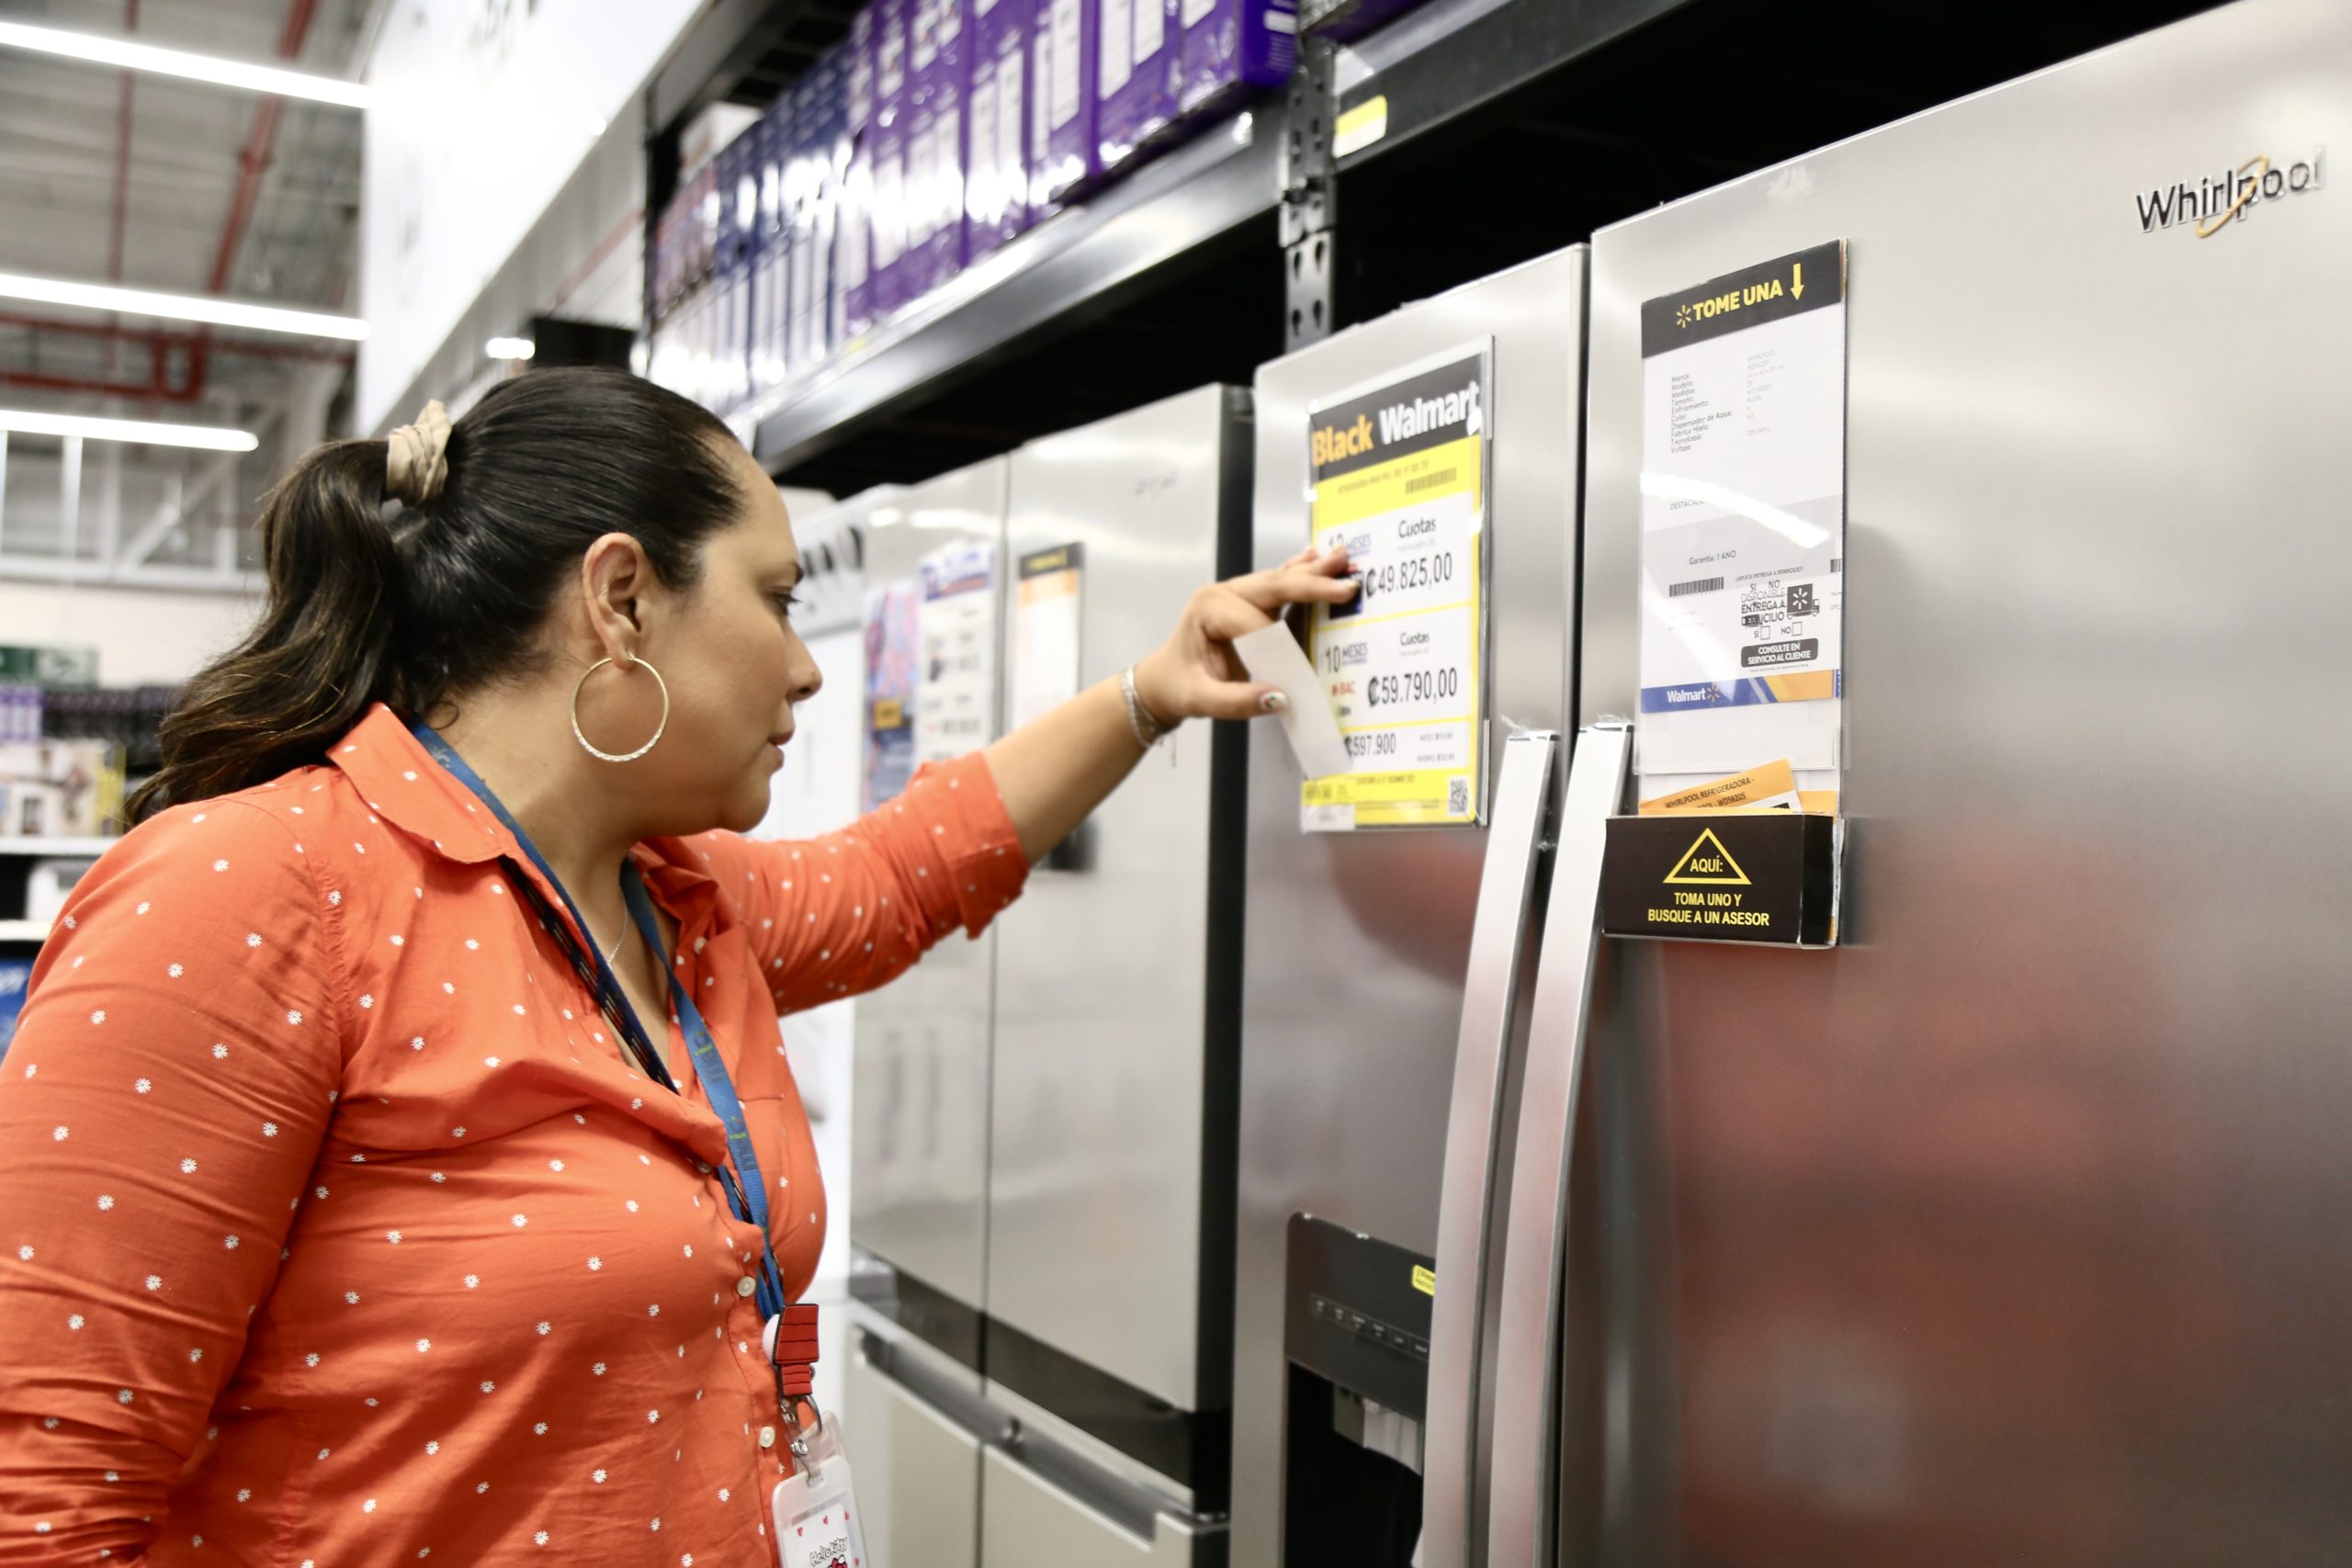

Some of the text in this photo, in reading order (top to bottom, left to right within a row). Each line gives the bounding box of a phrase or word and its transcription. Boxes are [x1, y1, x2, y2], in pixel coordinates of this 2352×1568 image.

[2136, 145, 2325, 233] Whirlpool
[1692, 279, 1783, 321] TOME UNA
[1311, 380, 1480, 467] Black Walmart
[1669, 499, 1704, 511] DESTACA
[1398, 517, 1436, 539] Cuotas
[1769, 580, 1781, 589] NO
[1741, 601, 1777, 614] ENTREGA
[1399, 631, 1430, 647] Cuotas
[1781, 626, 1792, 635] NO
[1758, 642, 1801, 655] CONSULTE EN
[1325, 645, 1341, 674] 10
[1747, 650, 1812, 665] SERVICIO AL CLIENTE
[1667, 687, 1707, 704] Walmart
[1665, 792, 1701, 808] WHIRLPOOL
[1701, 777, 1750, 798] REFRIGERADORA
[1690, 855, 1724, 873] AQUÍ:
[1674, 892, 1742, 907] TOMA UNO Y
[1647, 908, 1770, 926] BUSQUE A UN ASESOR
